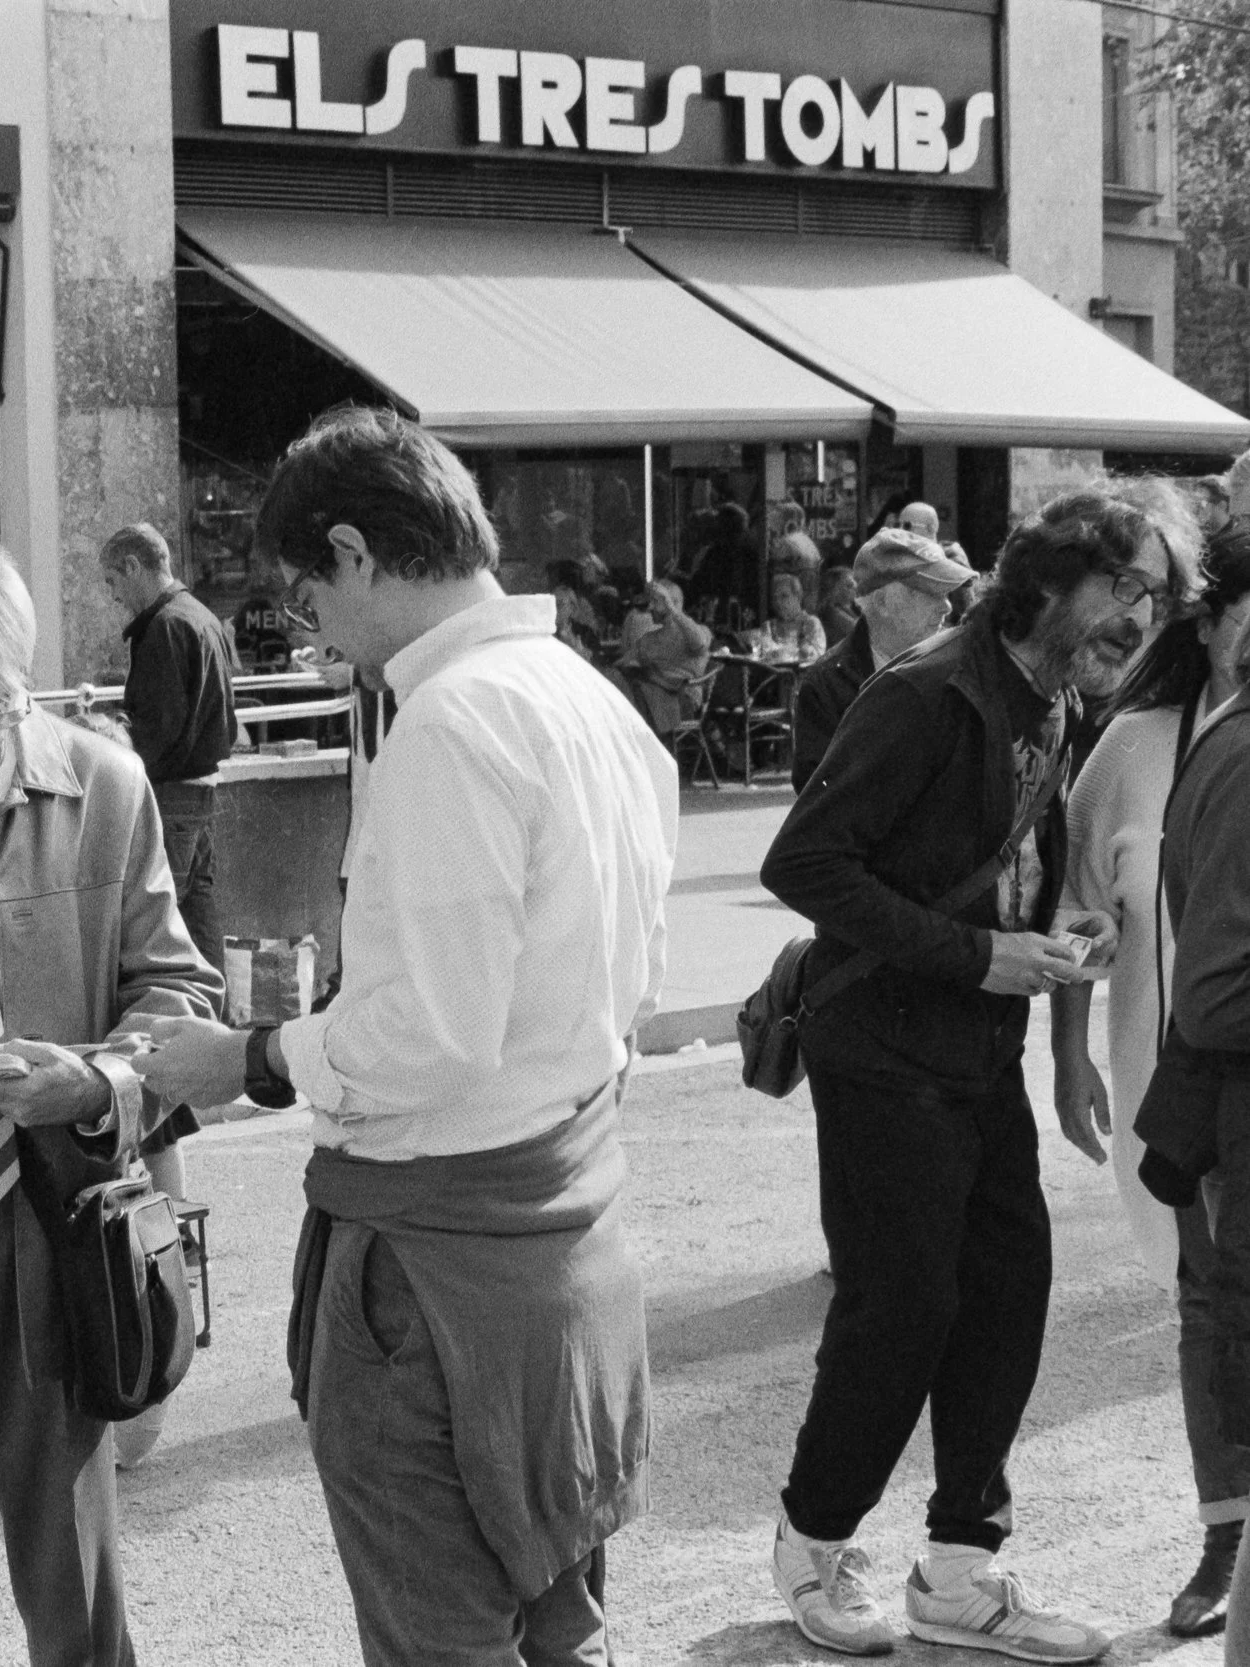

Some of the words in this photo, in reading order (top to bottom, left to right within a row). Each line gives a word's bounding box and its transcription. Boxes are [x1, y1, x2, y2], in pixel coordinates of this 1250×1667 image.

[218, 23, 426, 135] ELS
[455, 45, 702, 154] TRES
[725, 69, 994, 174] TOMBS
